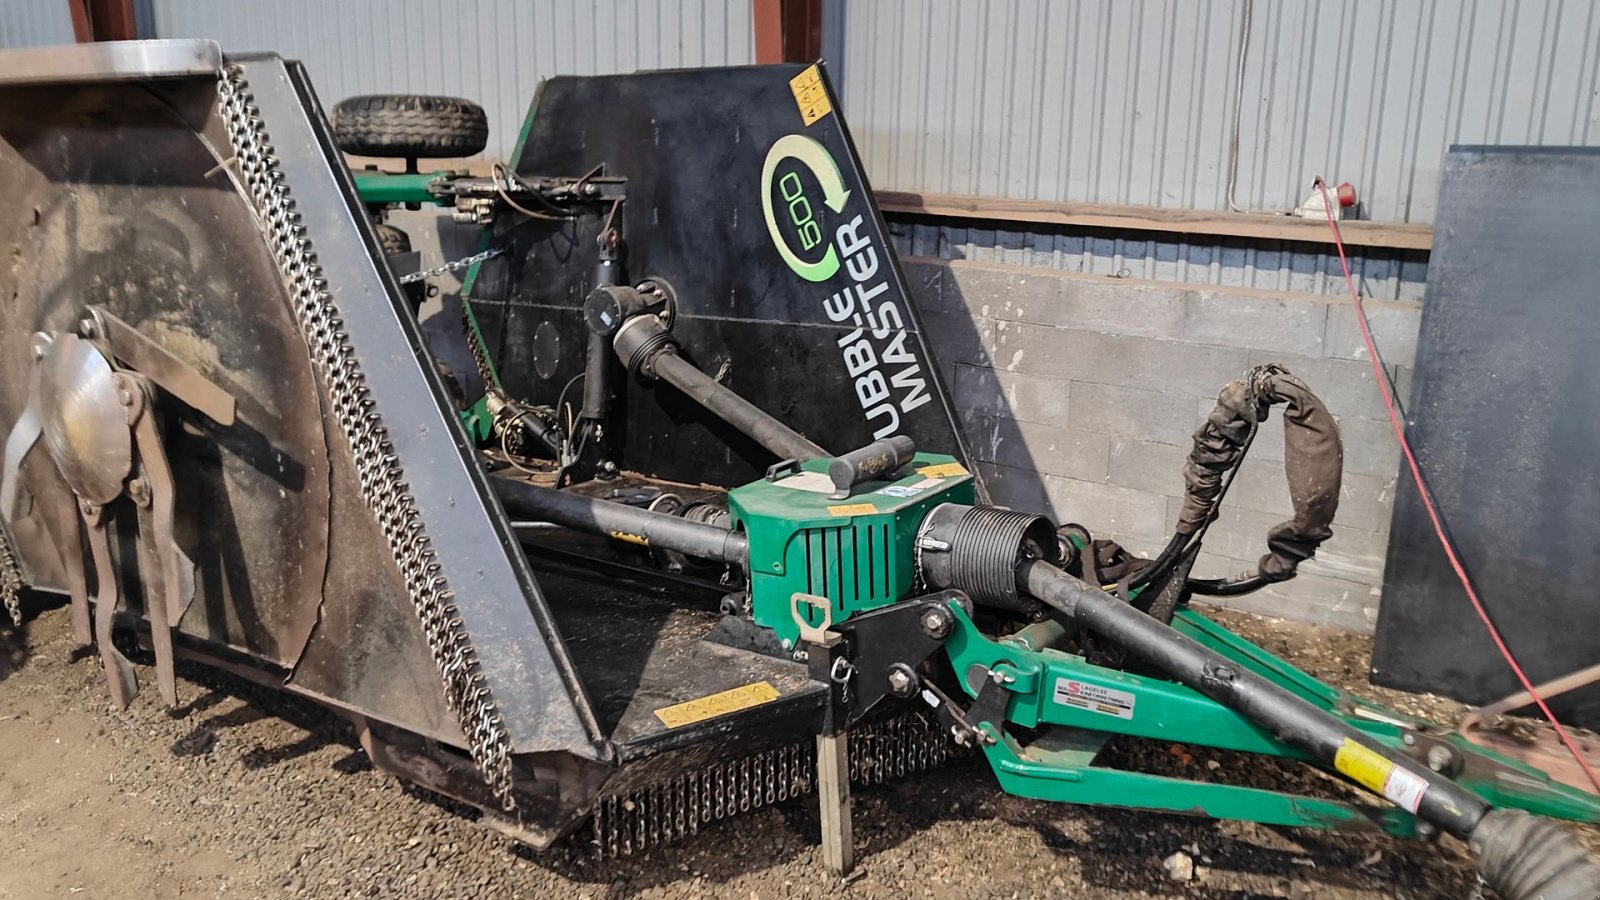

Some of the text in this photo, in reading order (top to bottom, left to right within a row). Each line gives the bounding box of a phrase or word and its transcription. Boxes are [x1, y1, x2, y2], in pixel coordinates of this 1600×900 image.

[779, 172, 822, 251] 500
[823, 286, 900, 440] UBBLE
[835, 214, 933, 415] MASTER
